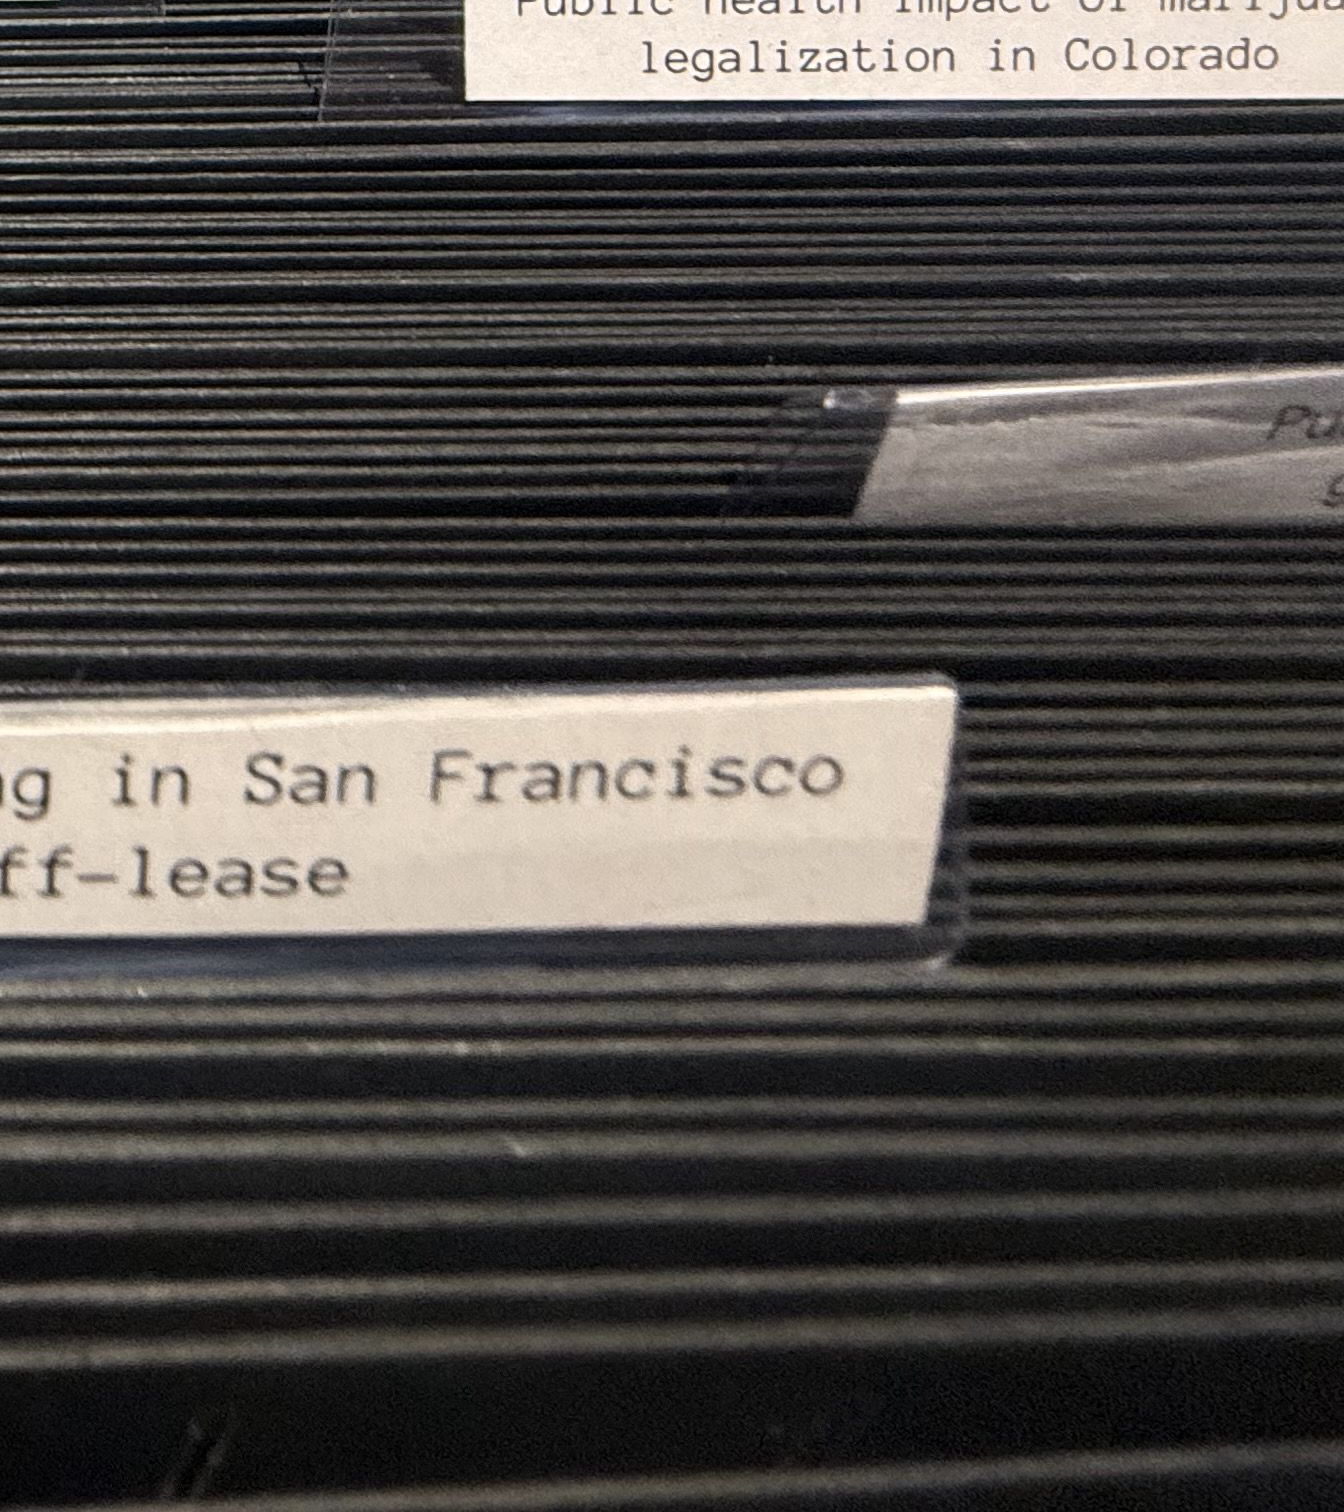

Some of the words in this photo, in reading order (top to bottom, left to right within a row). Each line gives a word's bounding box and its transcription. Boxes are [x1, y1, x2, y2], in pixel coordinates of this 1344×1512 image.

[643, 39, 954, 82] legalization
[990, 39, 1034, 71] in
[1065, 37, 1278, 71] Colorado
[113, 753, 190, 807] in
[244, 752, 377, 806] San
[430, 745, 844, 804] Francisco
